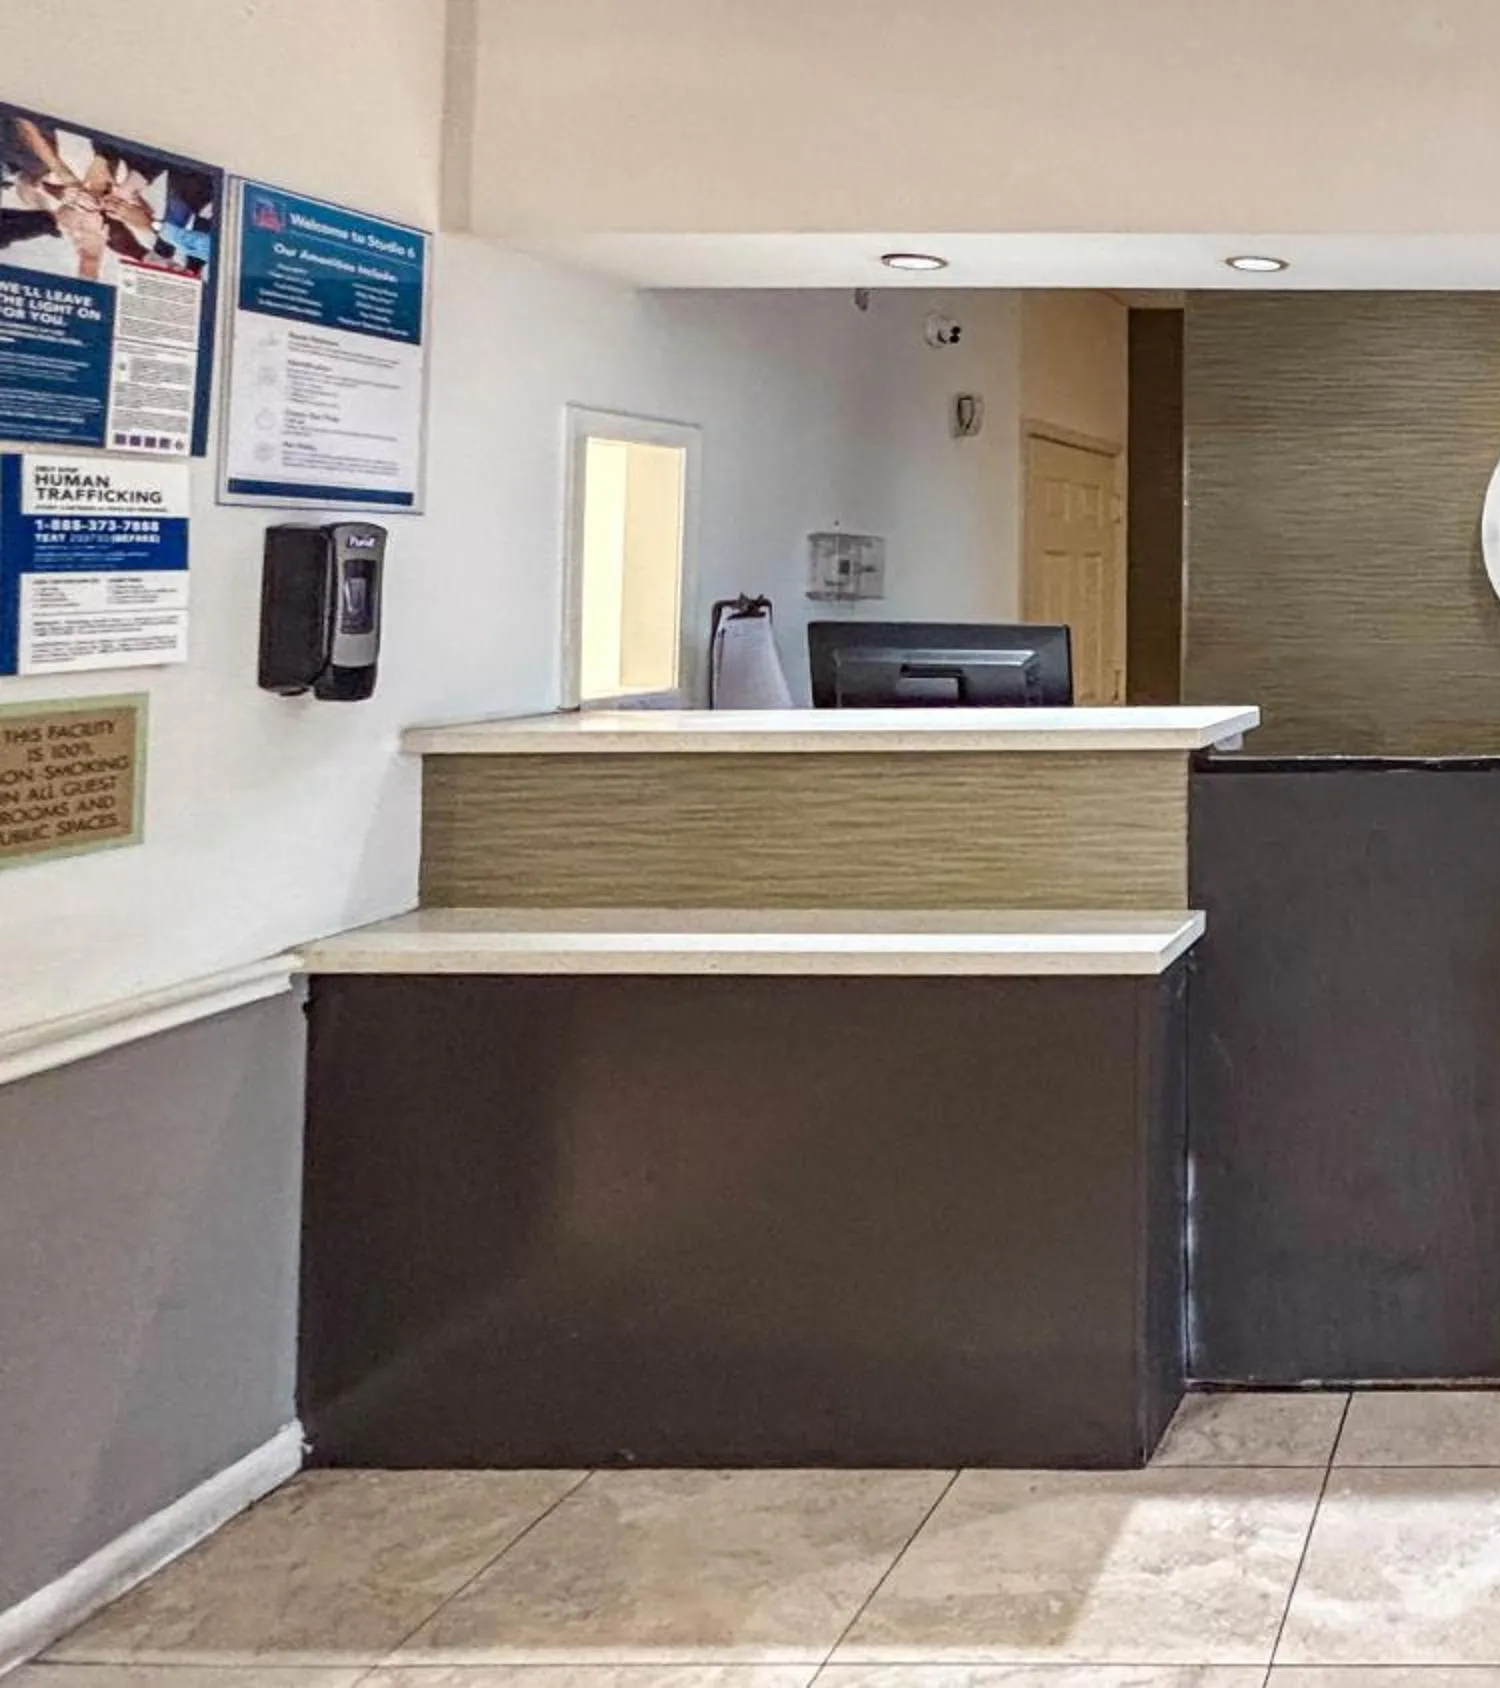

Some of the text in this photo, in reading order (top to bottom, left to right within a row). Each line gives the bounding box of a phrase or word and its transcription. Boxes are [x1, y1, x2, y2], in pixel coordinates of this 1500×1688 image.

[289, 212, 349, 240] Welcome
[351, 231, 366, 246] to
[367, 235, 406, 257] Studio
[407, 247, 418, 259] 6
[45, 289, 93, 307] LEAVE
[29, 299, 74, 316] LIGHT
[77, 307, 101, 321] ON
[34, 474, 110, 488] HUMAN
[36, 488, 163, 504] TRAFFICKING
[34, 519, 160, 533] 1-888-373-7888
[4, 727, 43, 745] THIS
[27, 747, 44, 763] IS
[28, 784, 54, 801] ALL
[61, 775, 117, 797] GUEST
[77, 795, 116, 813] AND
[0, 823, 51, 846] UBLIC
